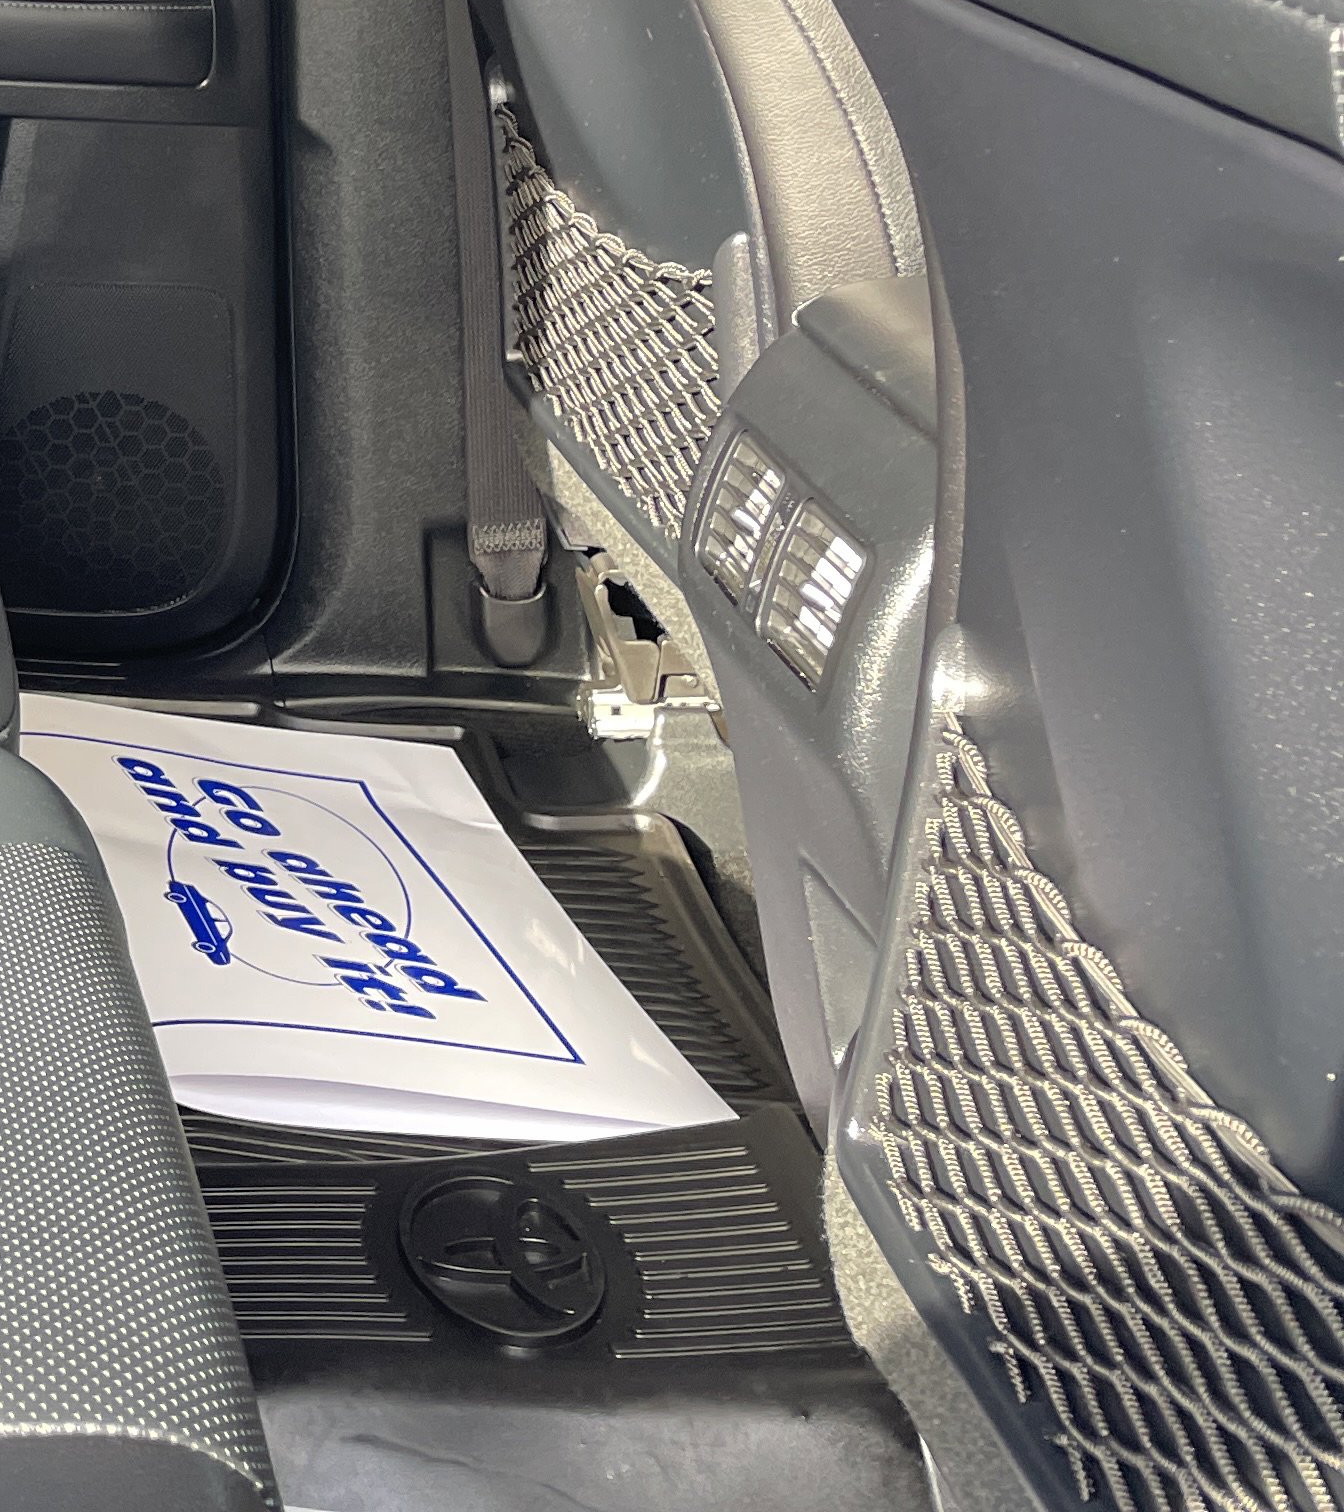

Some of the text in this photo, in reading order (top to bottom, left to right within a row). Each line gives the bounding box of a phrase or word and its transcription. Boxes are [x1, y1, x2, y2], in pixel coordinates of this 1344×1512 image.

[113, 755, 437, 1020] and buy it!
[194, 777, 489, 1003] Go ahead
